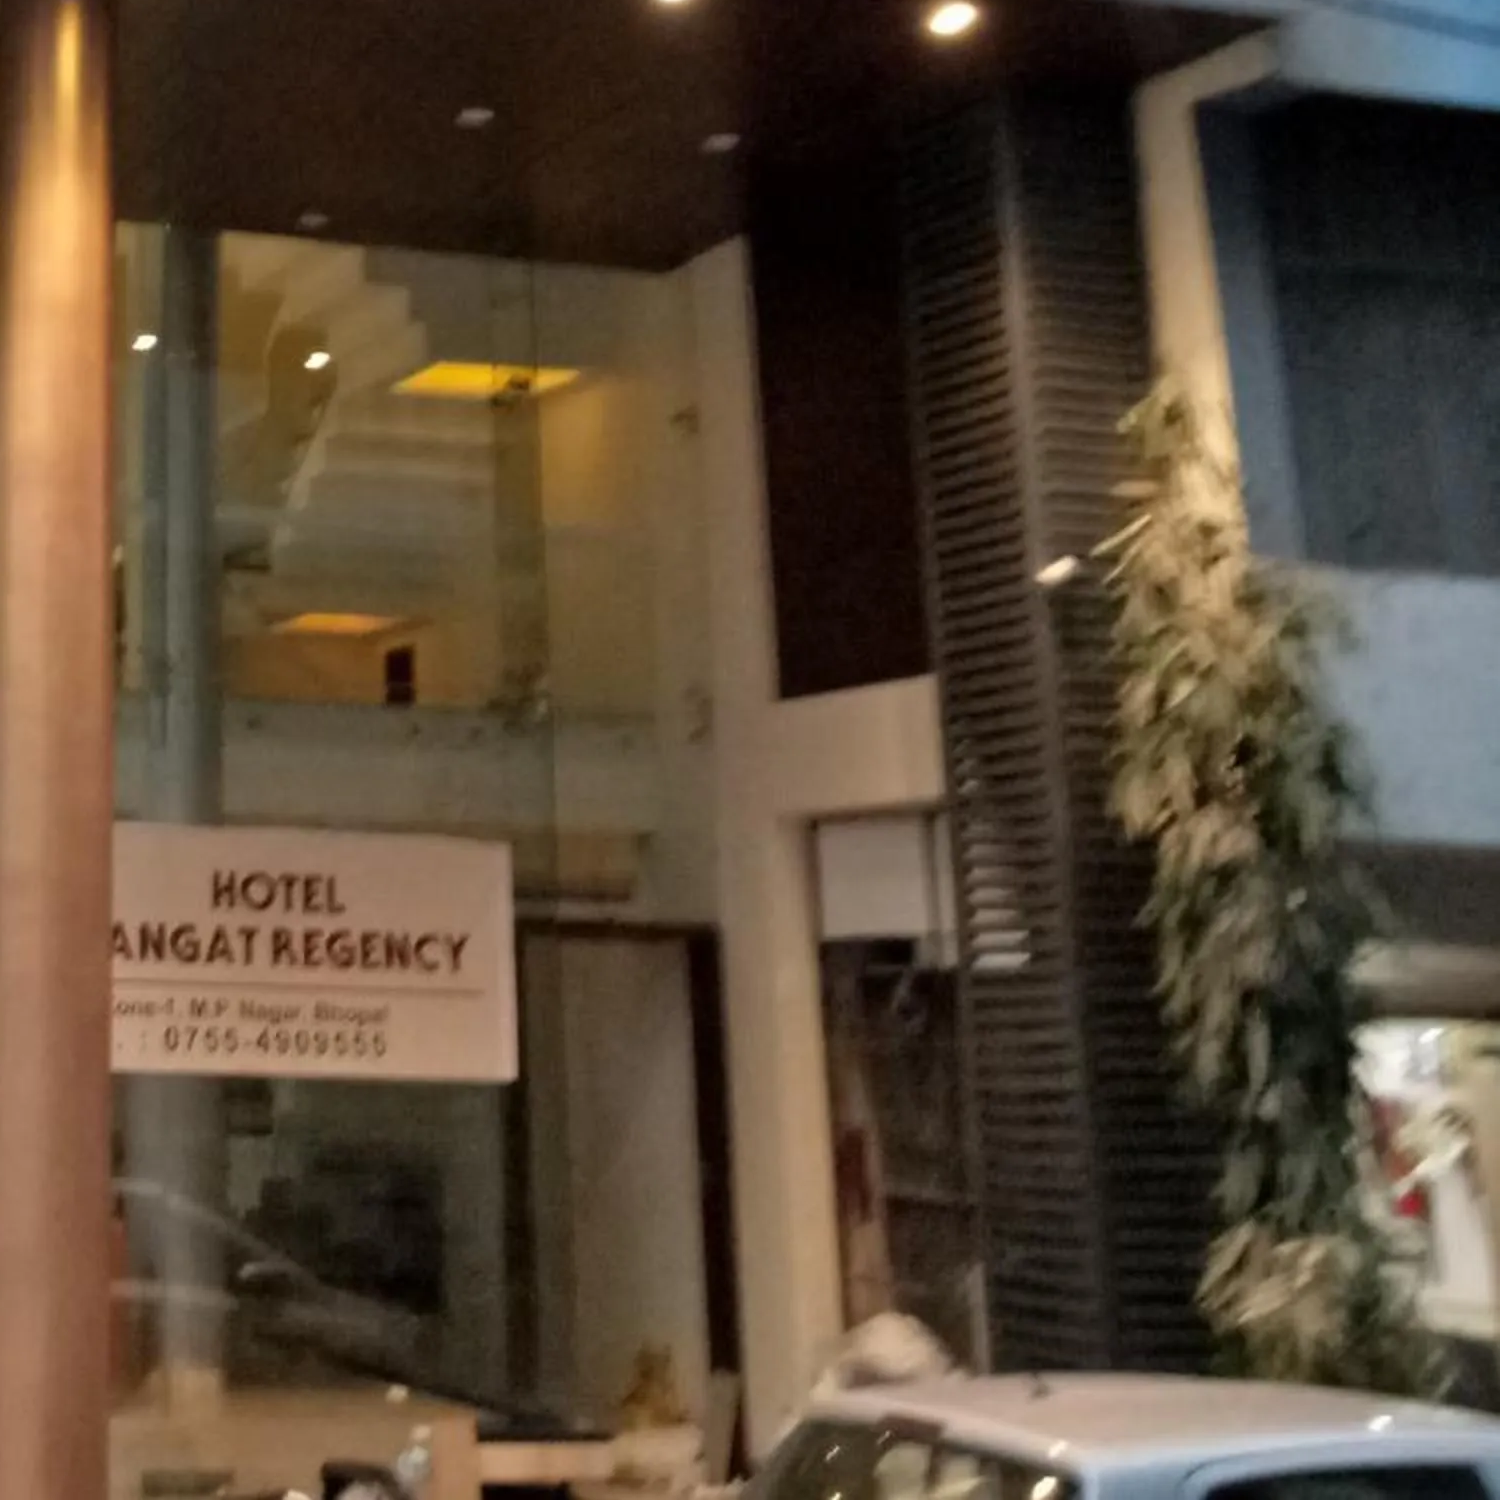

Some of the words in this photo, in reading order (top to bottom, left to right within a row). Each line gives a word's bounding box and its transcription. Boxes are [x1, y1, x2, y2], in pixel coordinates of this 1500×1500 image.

[211, 870, 348, 915] HOTEL
[111, 920, 260, 966] ANGAT
[272, 927, 471, 973] REGENCY
